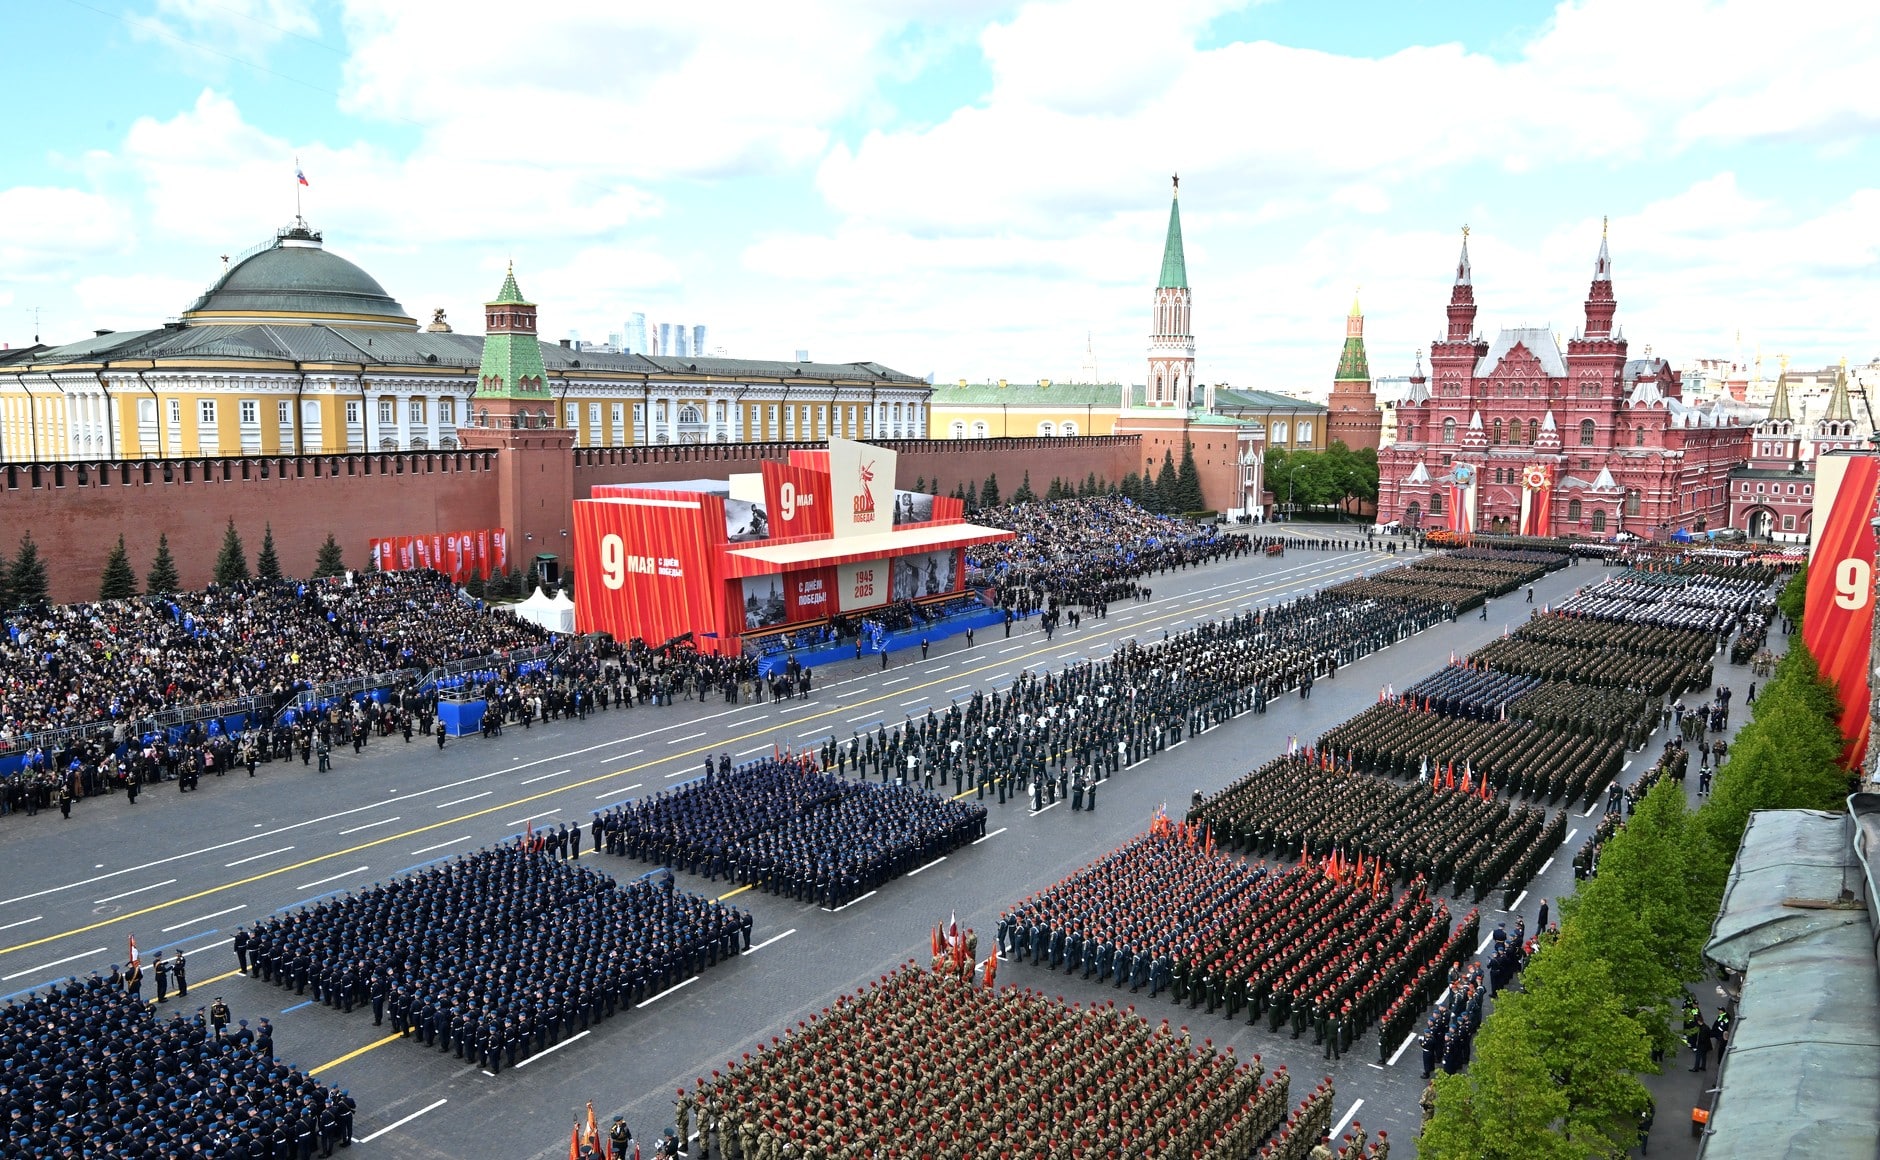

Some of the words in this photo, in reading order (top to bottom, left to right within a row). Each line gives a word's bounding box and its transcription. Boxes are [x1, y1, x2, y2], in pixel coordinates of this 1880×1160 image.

[781, 482, 795, 521] 9
[796, 494, 813, 507] МАЯ
[853, 495, 866, 511] 80
[853, 514, 875, 523] ПОБЕДА!
[383, 542, 391, 553] 9
[416, 539, 424, 551] 9
[447, 536, 455, 548] 9
[463, 535, 471, 547] 9
[601, 533, 625, 590] 9
[627, 555, 655, 575] МАЯ
[658, 558, 663, 566] С
[856, 570, 873, 584] 1945
[798, 582, 804, 592] С
[804, 579, 823, 592] ДНЁМ
[1835, 558, 1870, 610] 9
[854, 584, 873, 598] 2025
[798, 592, 827, 606] ПОБЕДЫ!
